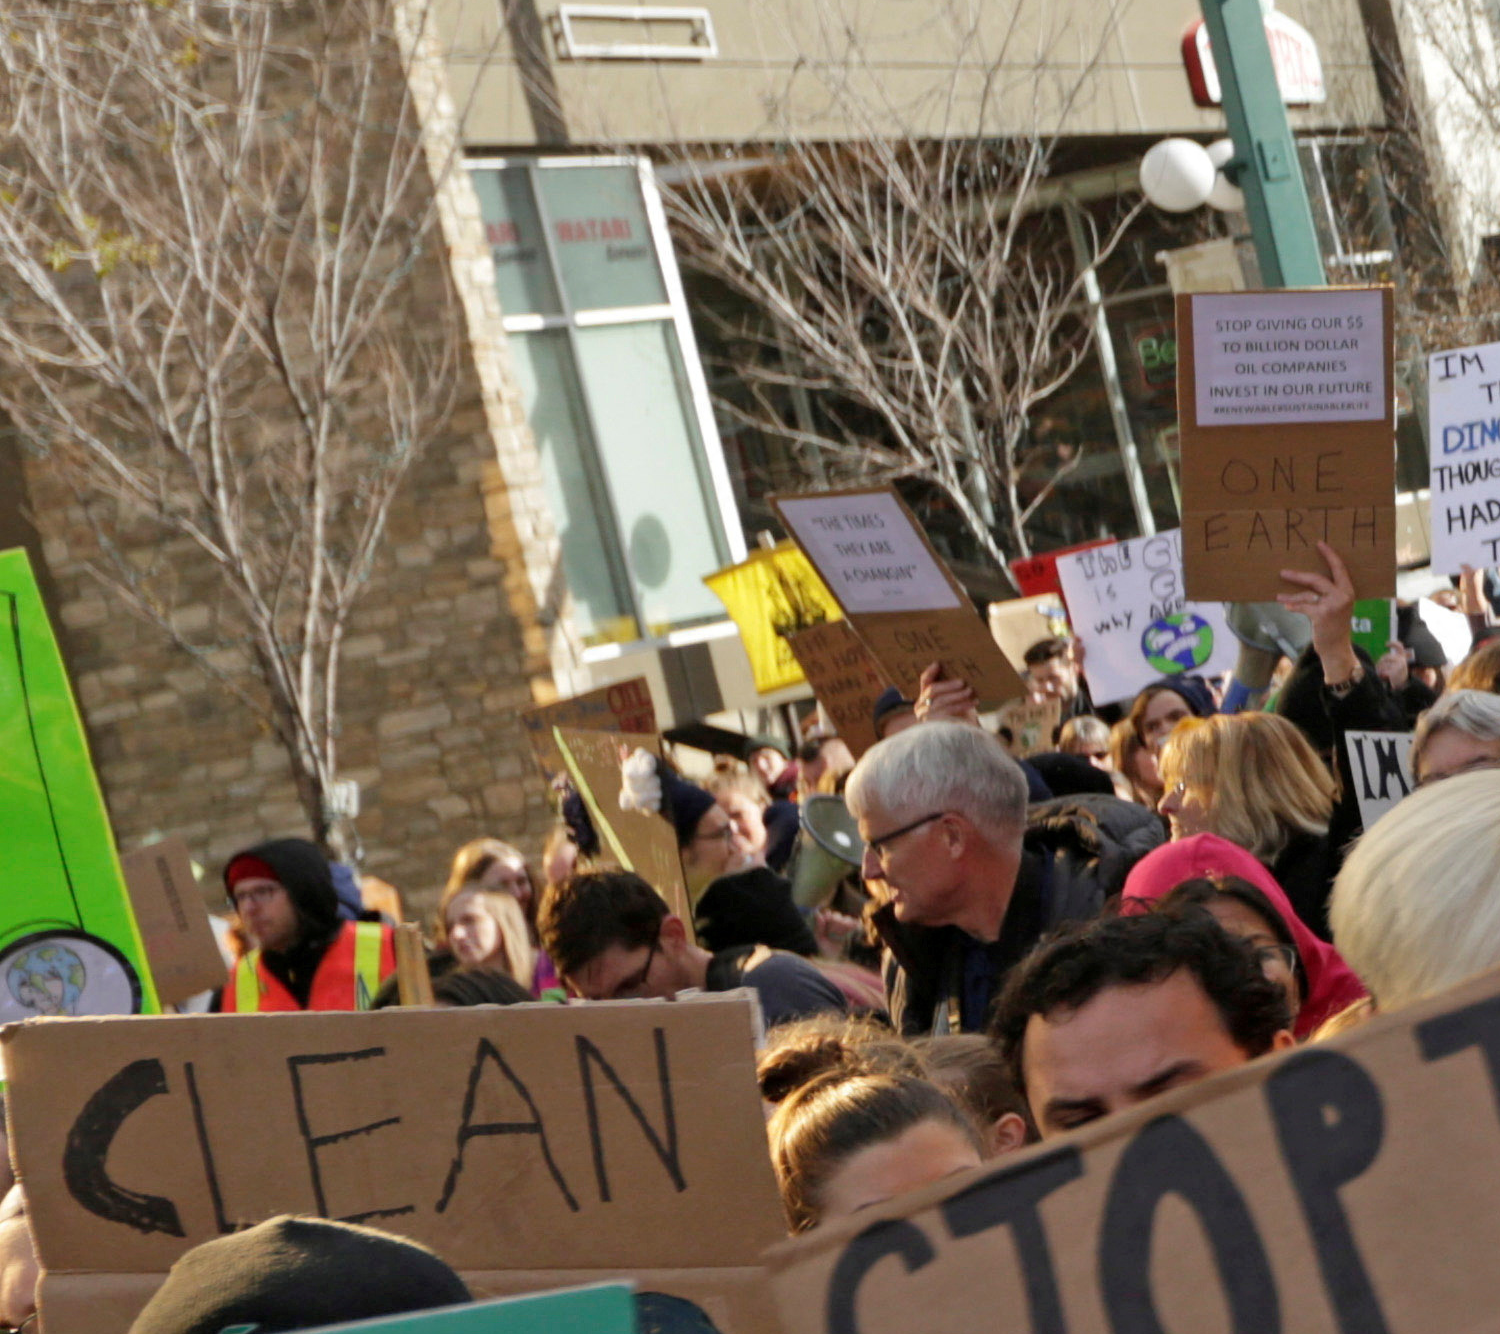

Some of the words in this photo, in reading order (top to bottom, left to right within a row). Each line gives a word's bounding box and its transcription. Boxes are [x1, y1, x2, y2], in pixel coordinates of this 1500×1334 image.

[1215, 319, 1251, 333] STOP
[1256, 317, 1308, 331] GIVING
[1311, 316, 1342, 330] OUR
[1222, 341, 1241, 354] TO
[1245, 339, 1300, 354] BILLION
[1304, 337, 1359, 352] DOLLAR
[1234, 362, 1258, 376] OIL
[1261, 360, 1348, 375] COMPANIES
[1209, 385, 1259, 398] INVEST
[1263, 384, 1279, 397] IN
[1282, 382, 1314, 396] OUR
[1318, 381, 1373, 395] FUTURE
[1220, 450, 1344, 496] ONE
[1202, 505, 1378, 554] EARTH
[62, 1026, 687, 1237] CLEAN
